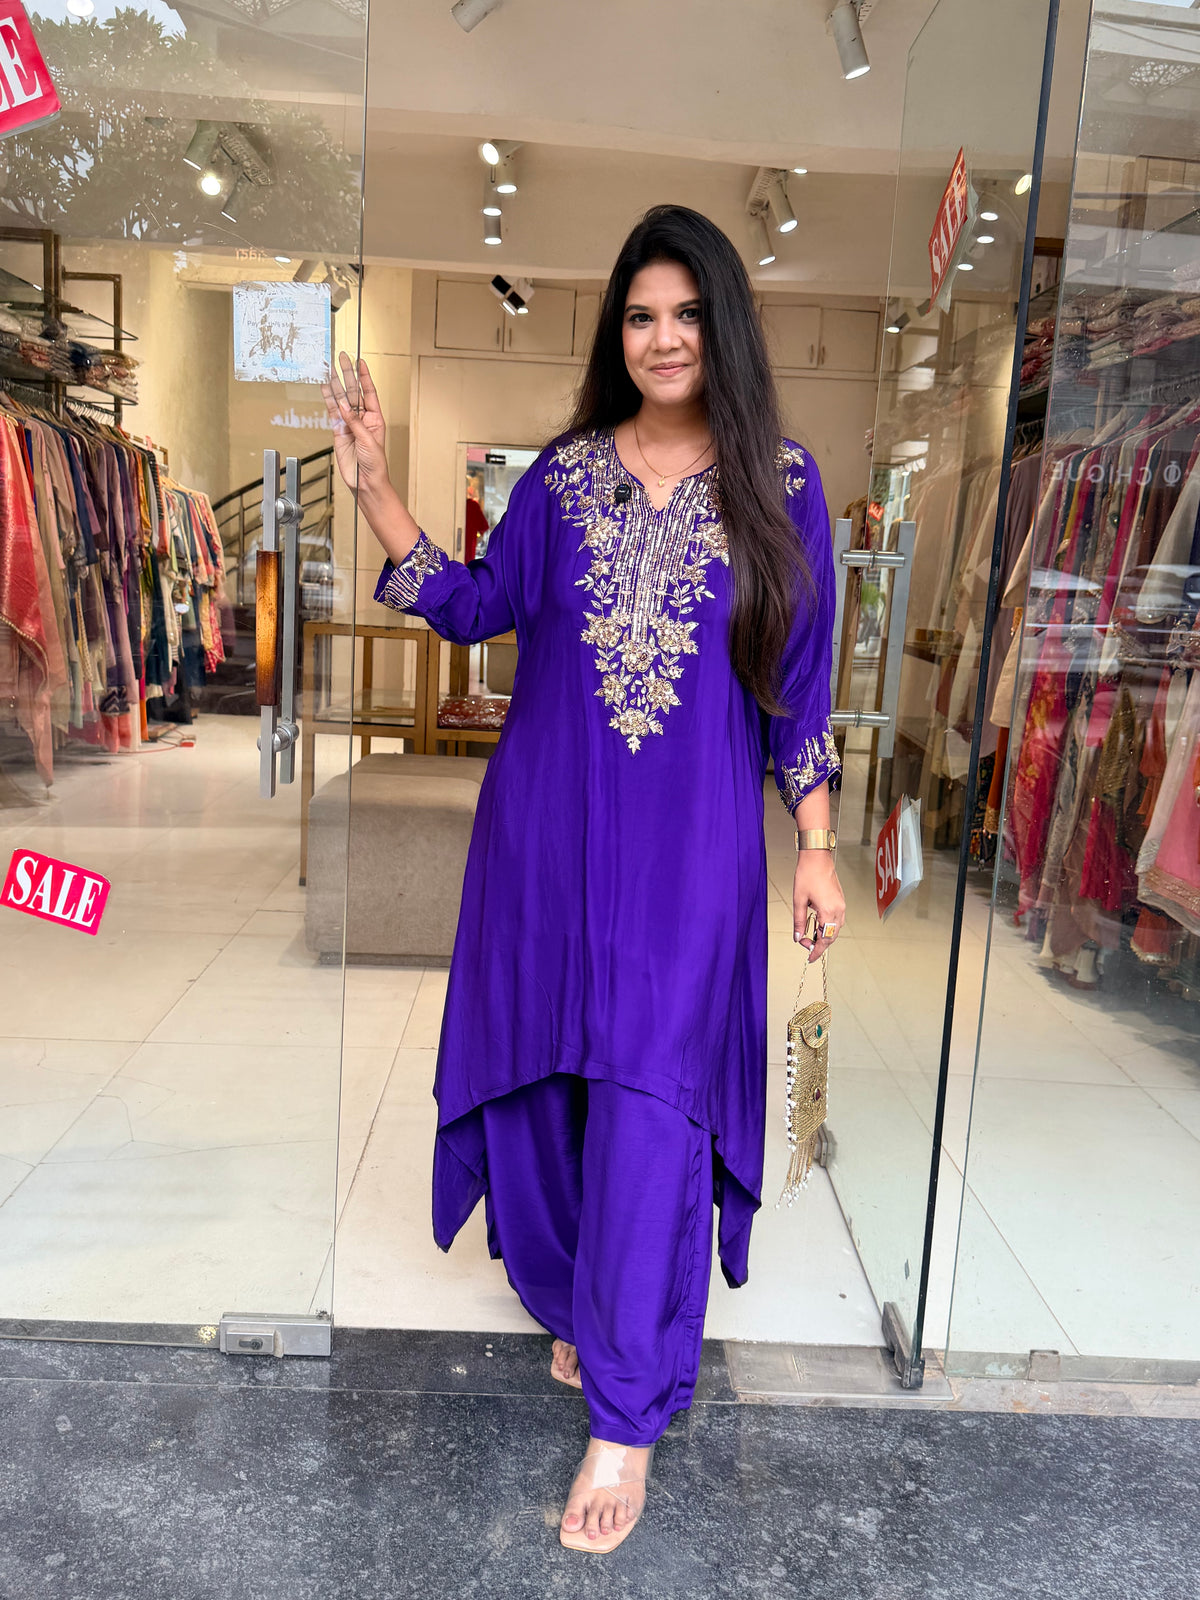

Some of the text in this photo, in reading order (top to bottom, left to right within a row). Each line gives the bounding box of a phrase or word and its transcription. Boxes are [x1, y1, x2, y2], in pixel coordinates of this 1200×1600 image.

[932, 166, 967, 295] SALE
[8, 856, 103, 928] SALE
[877, 816, 901, 900] SAL
